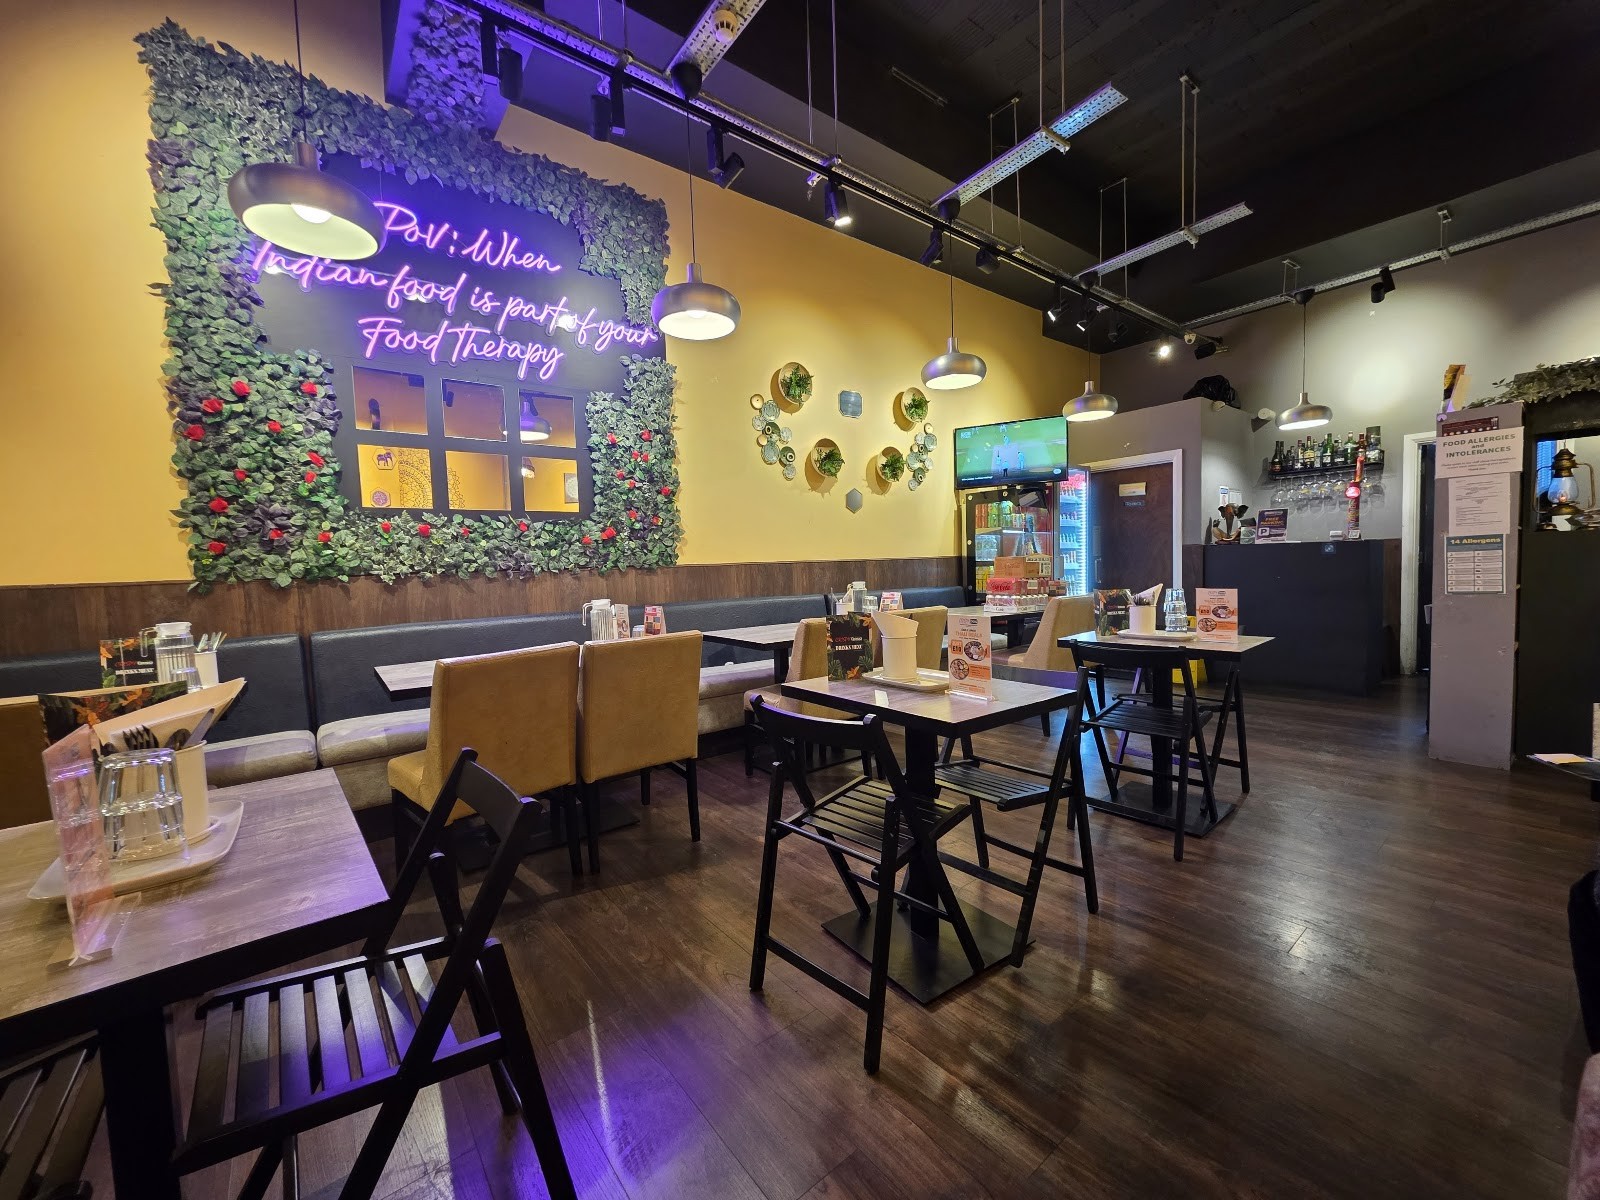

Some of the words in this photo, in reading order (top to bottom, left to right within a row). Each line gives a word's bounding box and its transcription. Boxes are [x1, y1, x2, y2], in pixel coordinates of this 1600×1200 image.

[462, 228, 561, 273] When
[251, 240, 389, 290] Indian
[387, 264, 467, 314] food
[470, 286, 501, 313] is
[497, 295, 569, 334] part
[562, 307, 597, 346] of
[594, 319, 659, 352] your
[357, 316, 448, 363] Food
[447, 322, 565, 381] Therapy
[1443, 439, 1466, 447] FOOD
[1468, 433, 1516, 445] ALLERGIES
[1446, 445, 1512, 458] INTOLERANCES
[1461, 537, 1502, 545] Allergens
